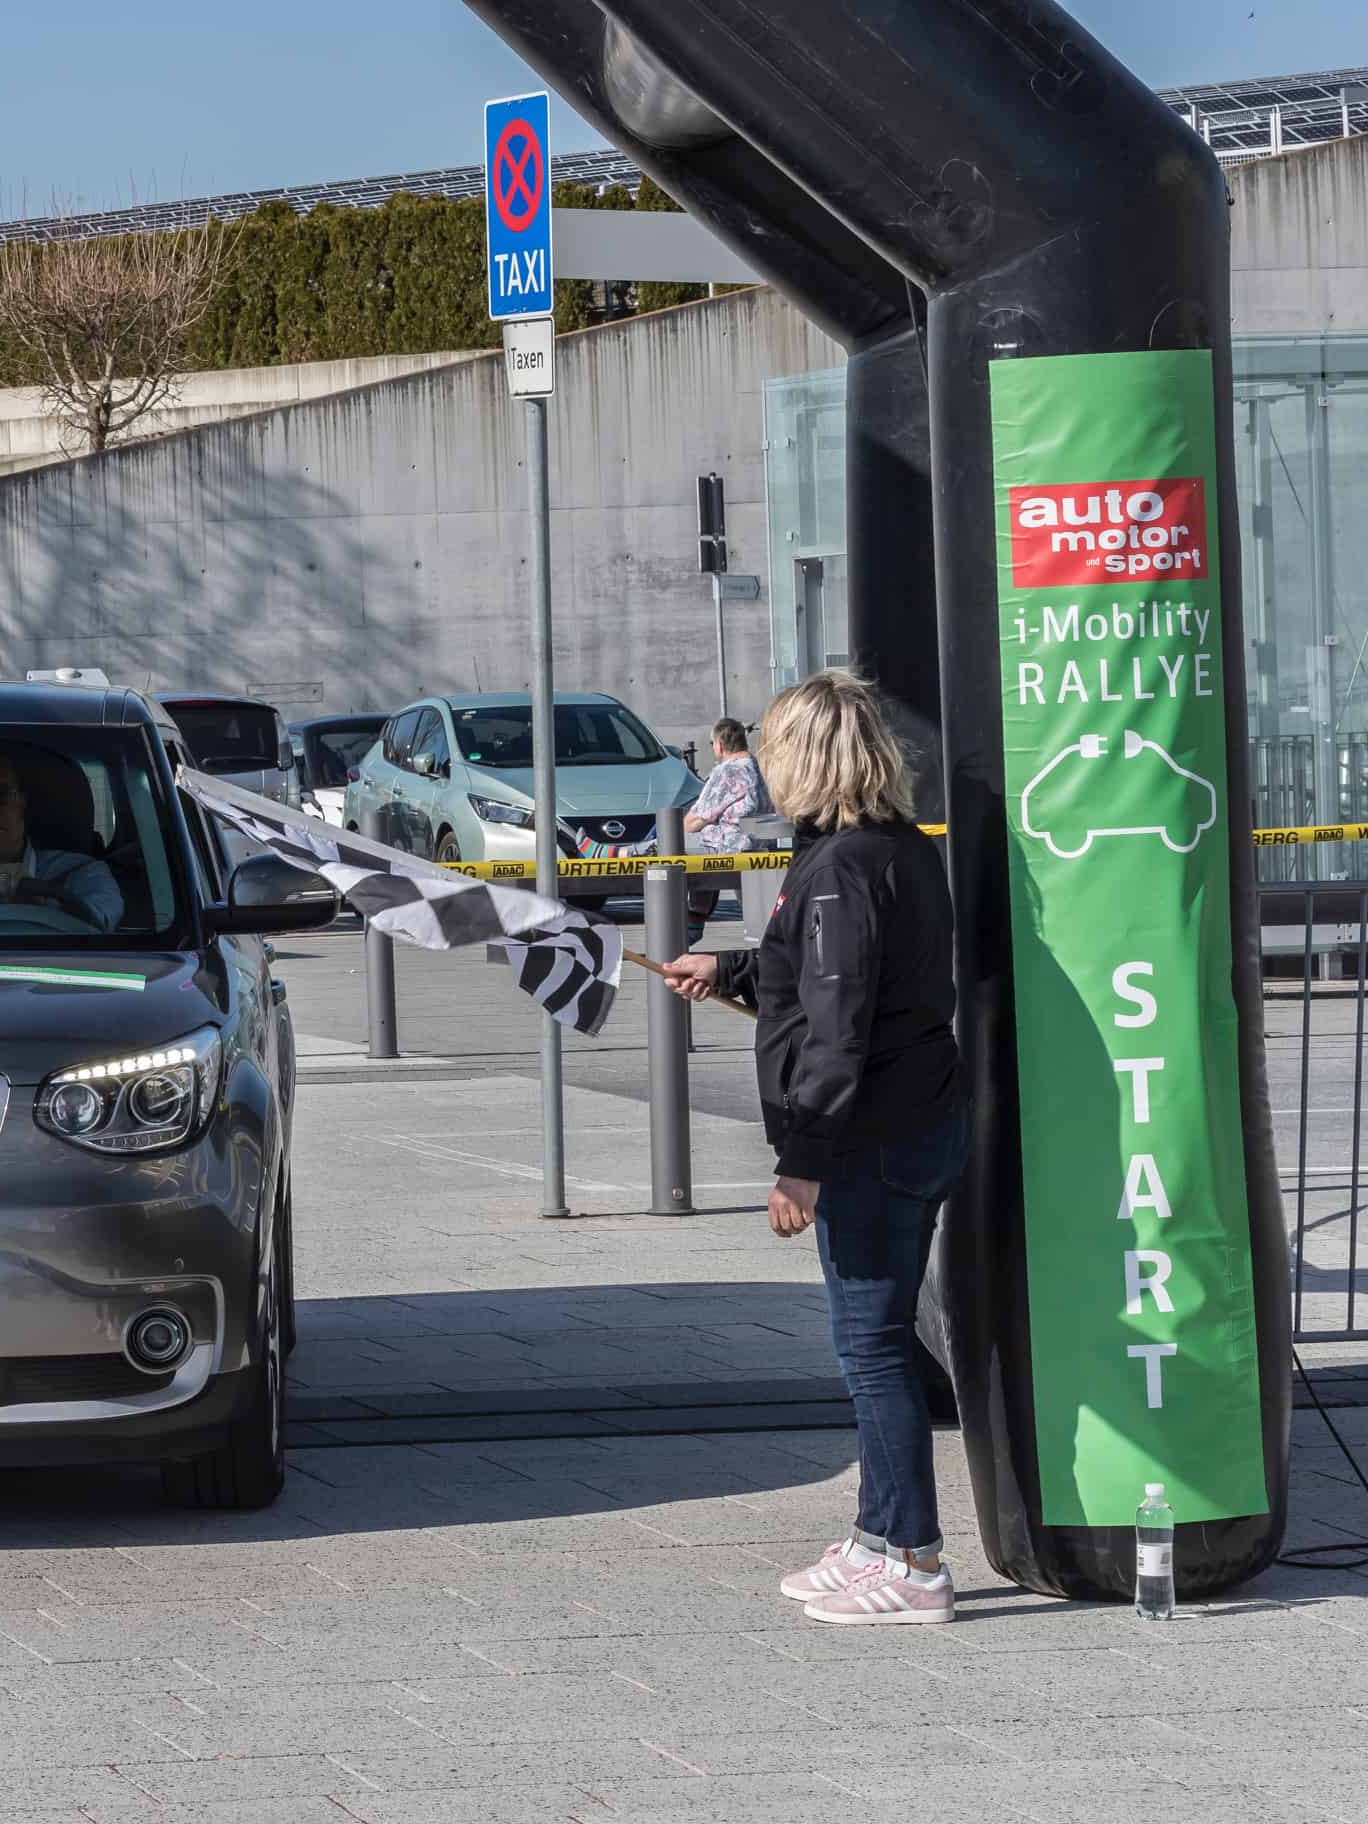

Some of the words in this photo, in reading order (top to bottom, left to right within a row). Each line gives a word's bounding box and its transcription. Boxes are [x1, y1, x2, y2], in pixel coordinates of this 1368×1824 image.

[494, 248, 546, 297] TAXI
[510, 347, 544, 371] Taxen
[1019, 489, 1164, 528] auto
[1050, 524, 1189, 553] motor
[1085, 556, 1100, 567] und
[1104, 548, 1202, 575] sport
[1012, 600, 1210, 645] i-Mobility
[1018, 653, 1213, 705] RALLYE
[1315, 829, 1343, 841] ADAC
[494, 865, 524, 877] ADAC
[704, 858, 734, 870] ADAC
